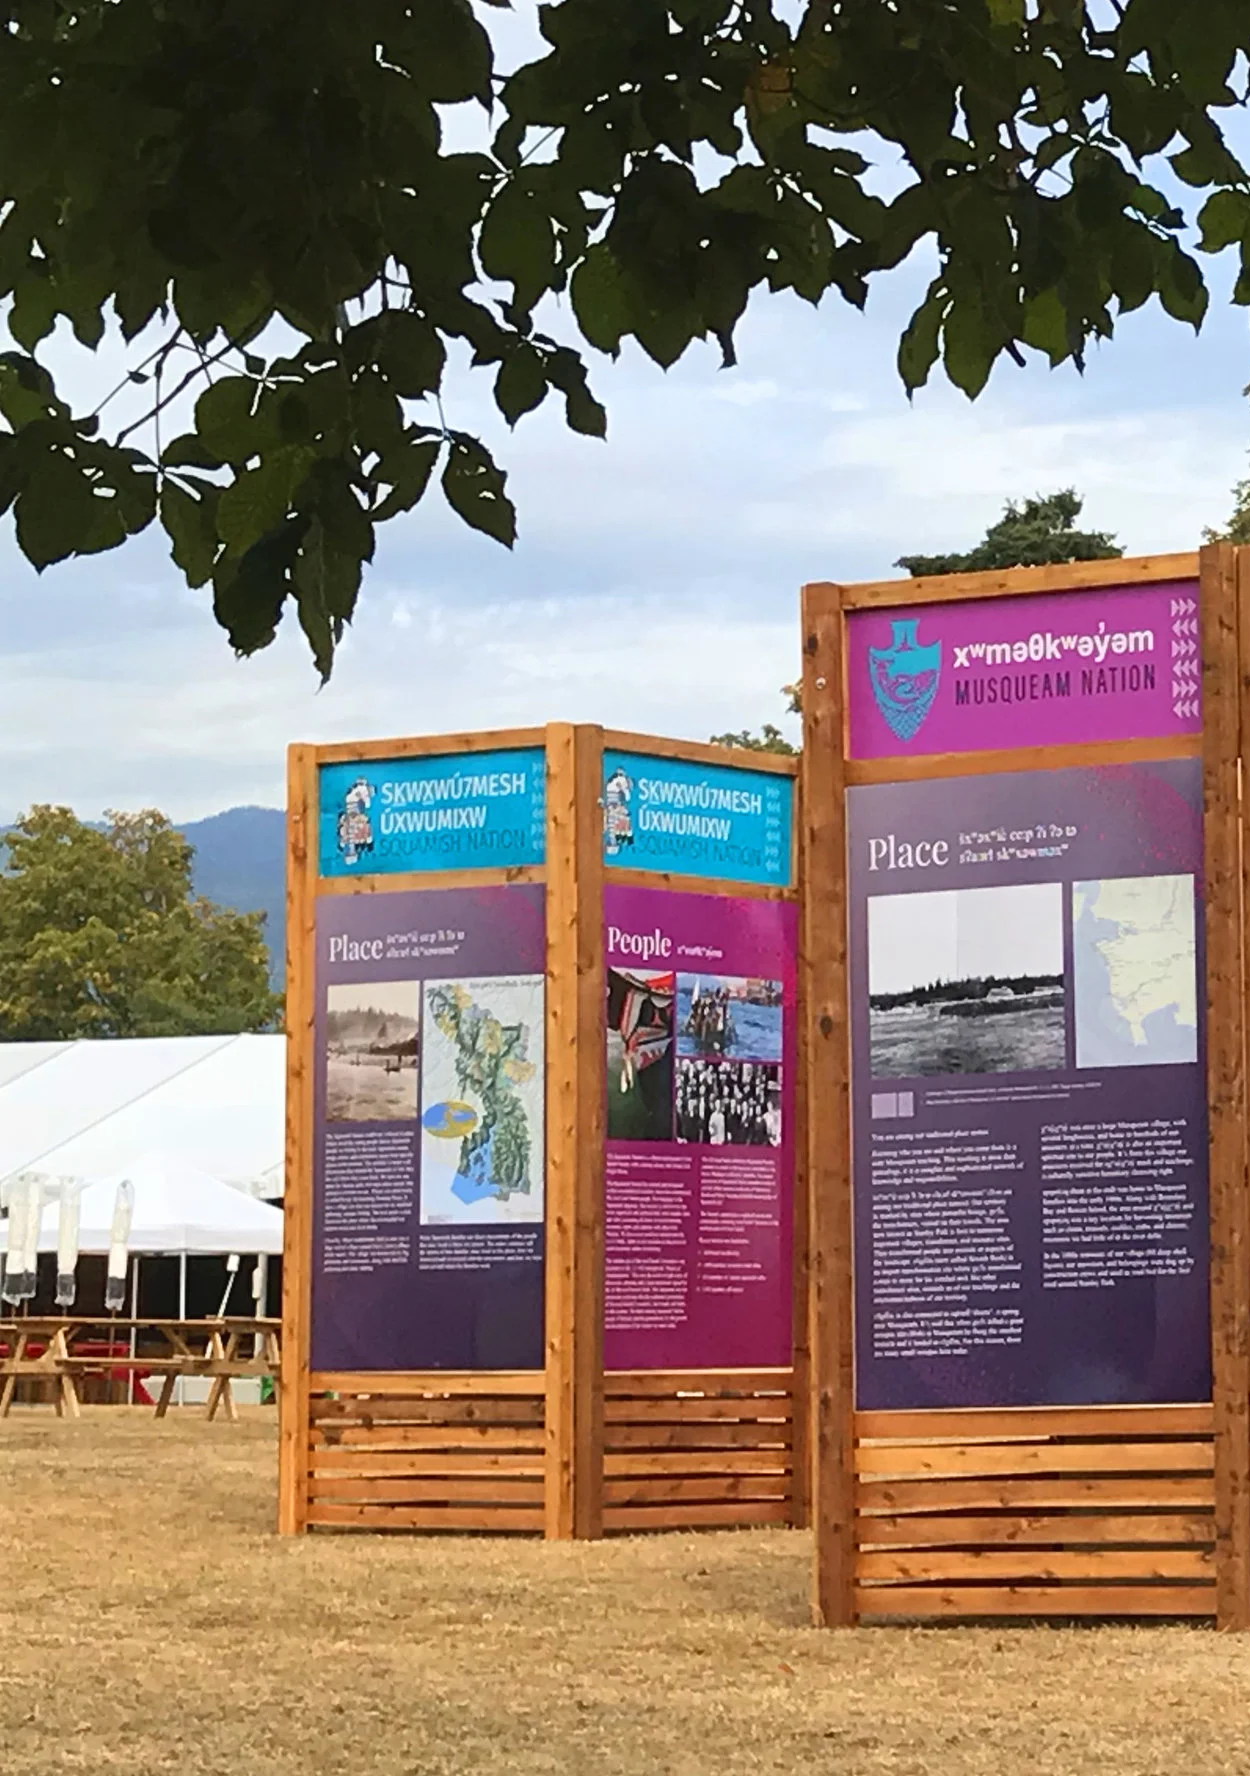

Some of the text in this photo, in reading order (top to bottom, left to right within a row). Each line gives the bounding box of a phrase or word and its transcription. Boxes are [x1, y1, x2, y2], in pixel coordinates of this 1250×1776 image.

[955, 664, 1156, 706] MUSQUEAM NATION
[468, 828, 526, 850] NATION
[868, 834, 949, 872] Place
[329, 934, 383, 962] Place
[608, 926, 672, 961] People
